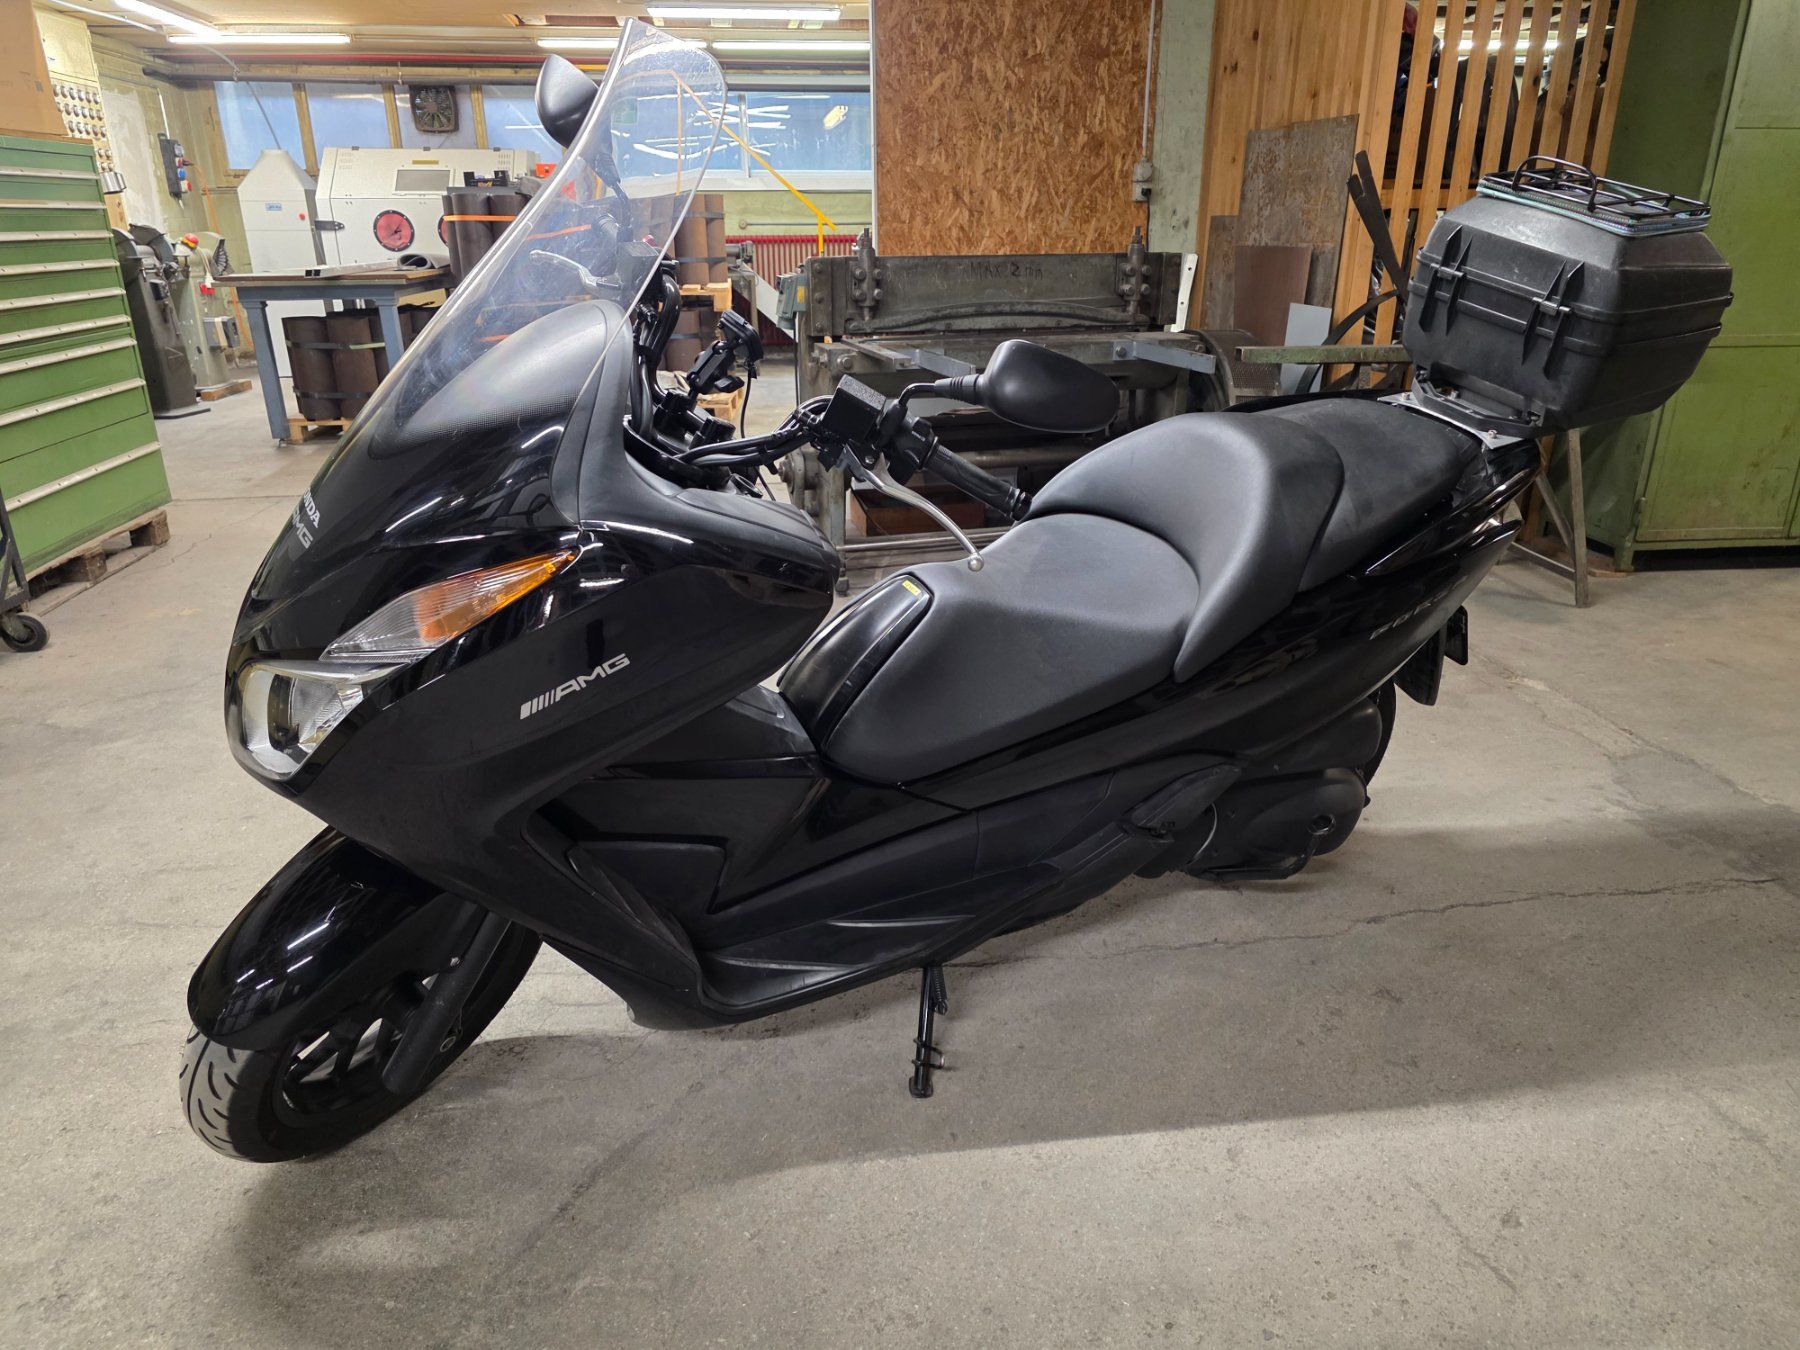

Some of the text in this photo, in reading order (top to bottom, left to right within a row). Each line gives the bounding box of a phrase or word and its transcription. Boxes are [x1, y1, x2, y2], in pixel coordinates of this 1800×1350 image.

[969, 261, 1002, 281] MAX
[1010, 261, 1022, 277] 2
[292, 505, 314, 549] AMG
[554, 653, 631, 703] AMG
